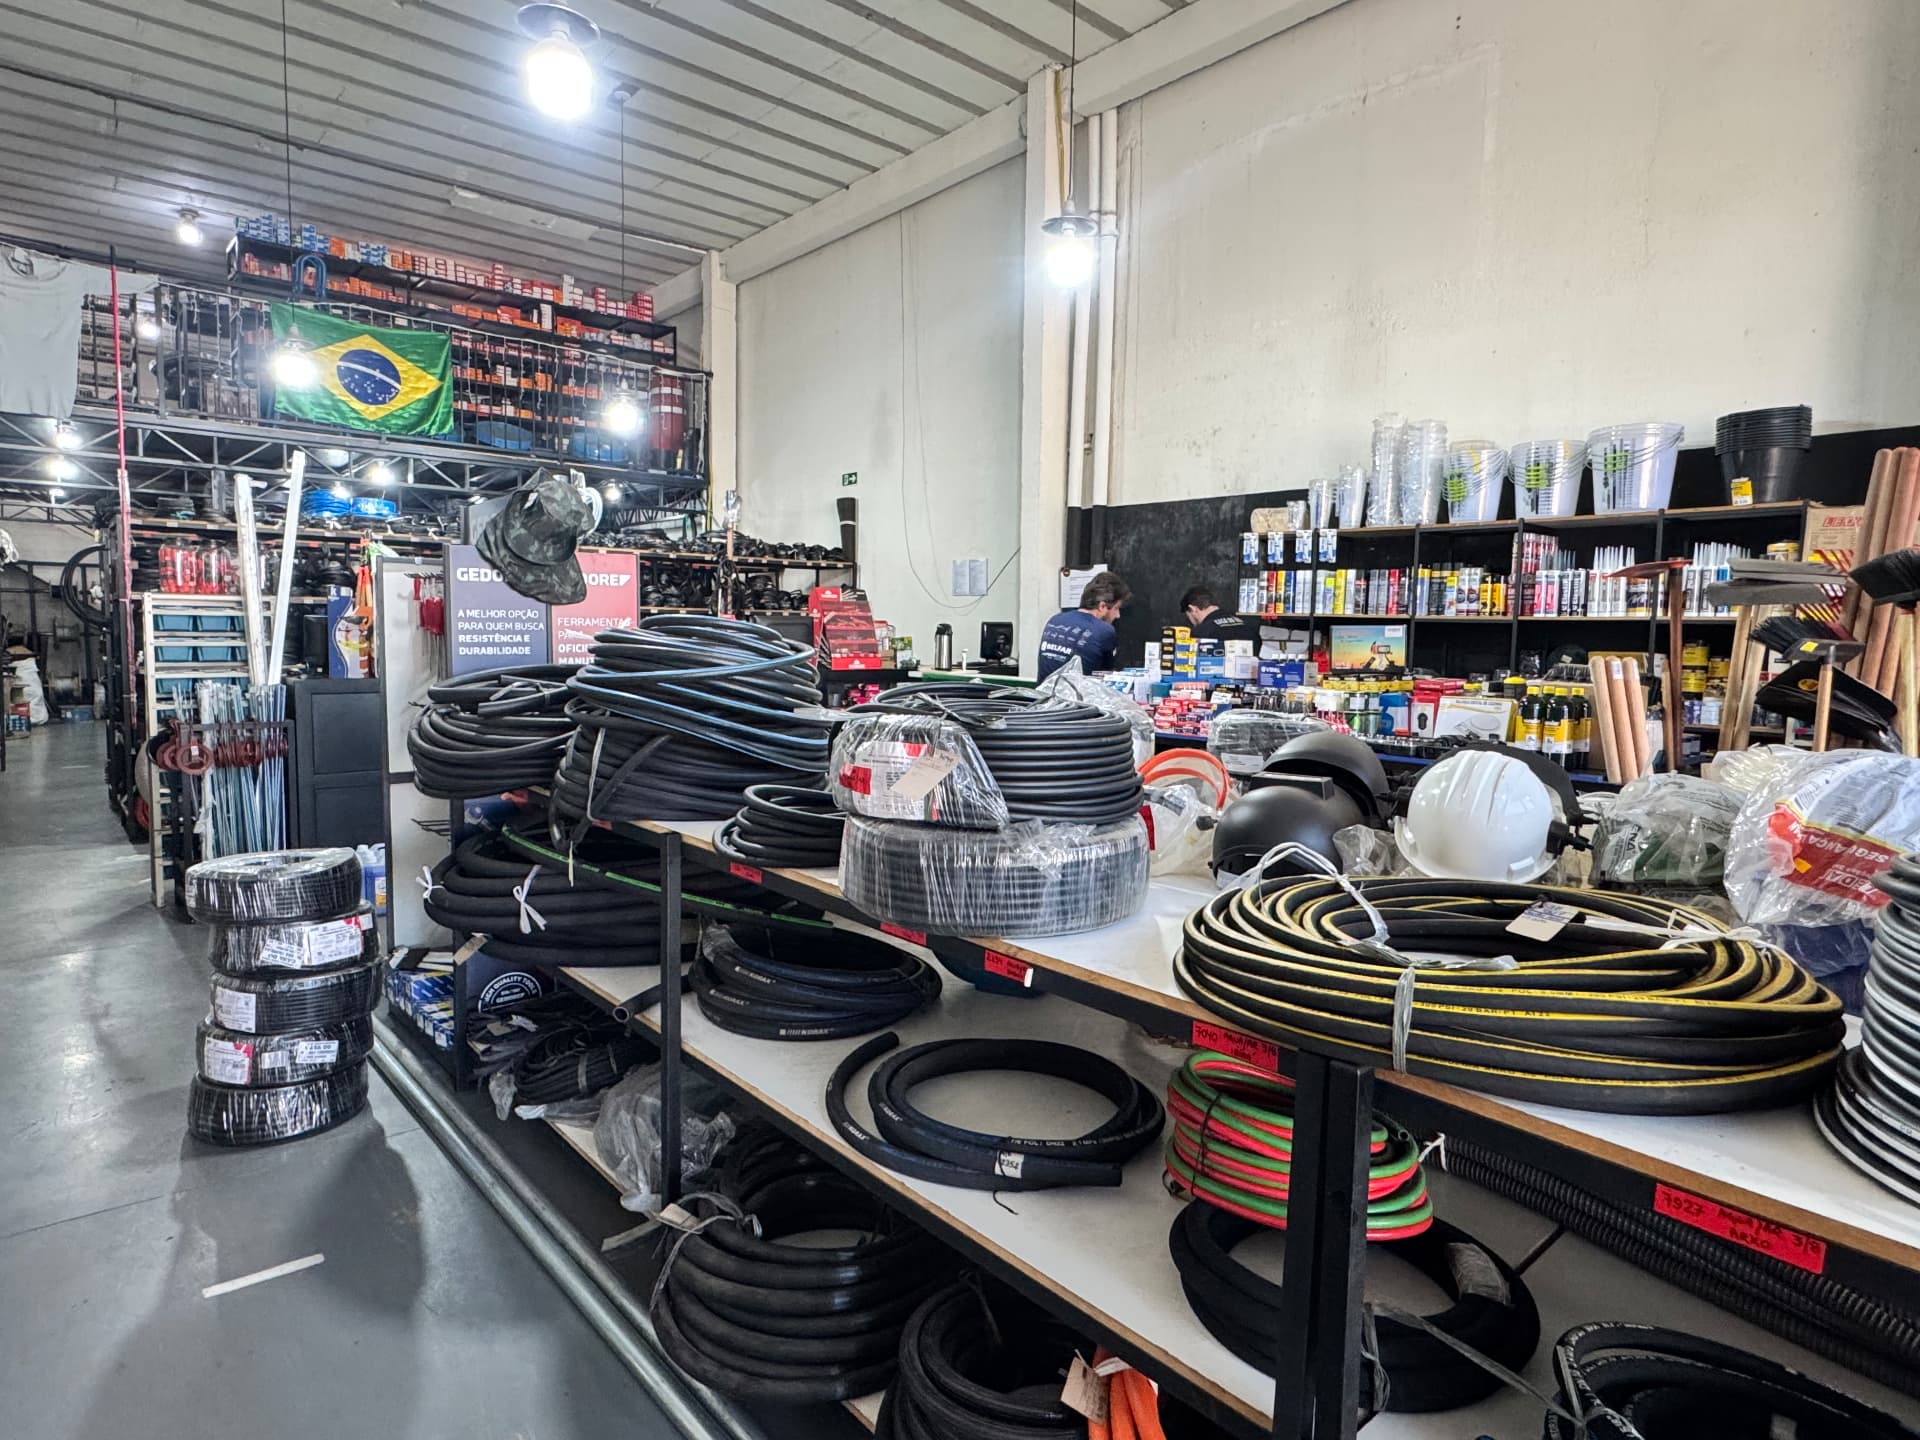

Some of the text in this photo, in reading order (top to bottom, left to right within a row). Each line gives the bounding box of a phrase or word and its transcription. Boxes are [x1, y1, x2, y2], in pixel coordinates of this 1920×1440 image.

[456, 567, 504, 582] GEDO
[457, 608, 539, 620] A MELHOR OPÇÃO
[458, 622, 544, 632] PARA QUEM BUSCA
[459, 632, 531, 643] RESISTÊNCIA E
[459, 646, 531, 655] DURABILIDADE
